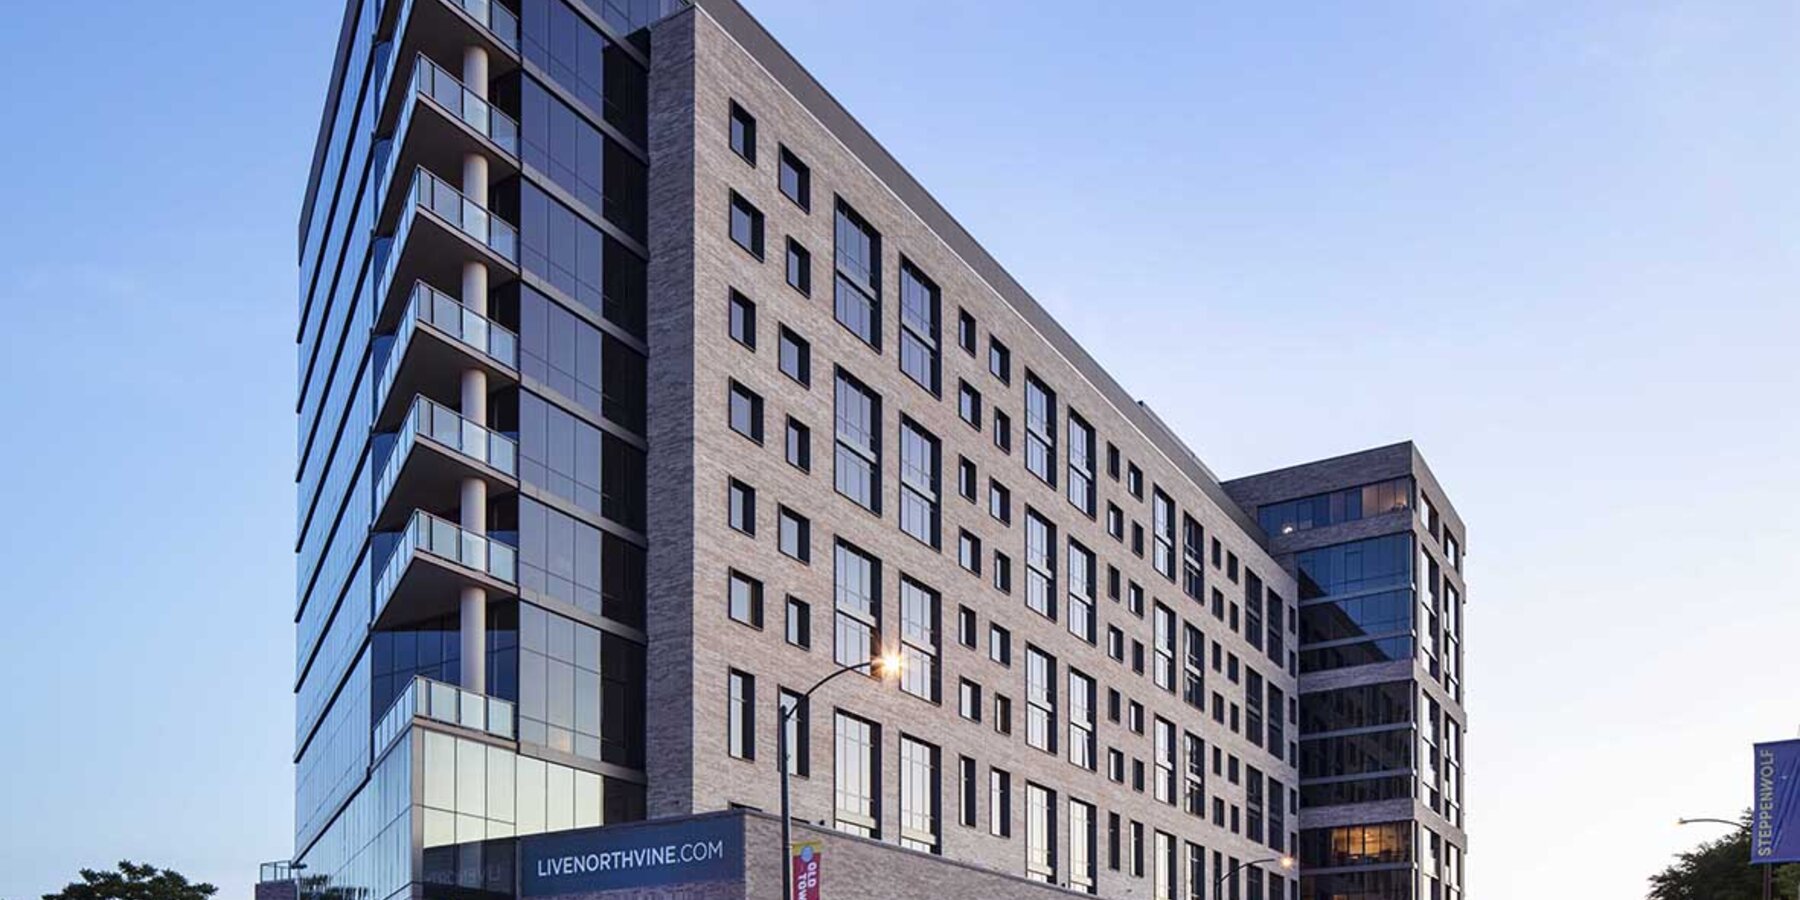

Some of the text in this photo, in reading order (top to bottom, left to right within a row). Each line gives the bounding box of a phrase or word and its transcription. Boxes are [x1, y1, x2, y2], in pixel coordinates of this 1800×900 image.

[1758, 749, 1774, 857] STEPPENWOLF
[537, 840, 723, 876] LIVENORTHVINE.COM
[807, 862, 817, 888] OLD
